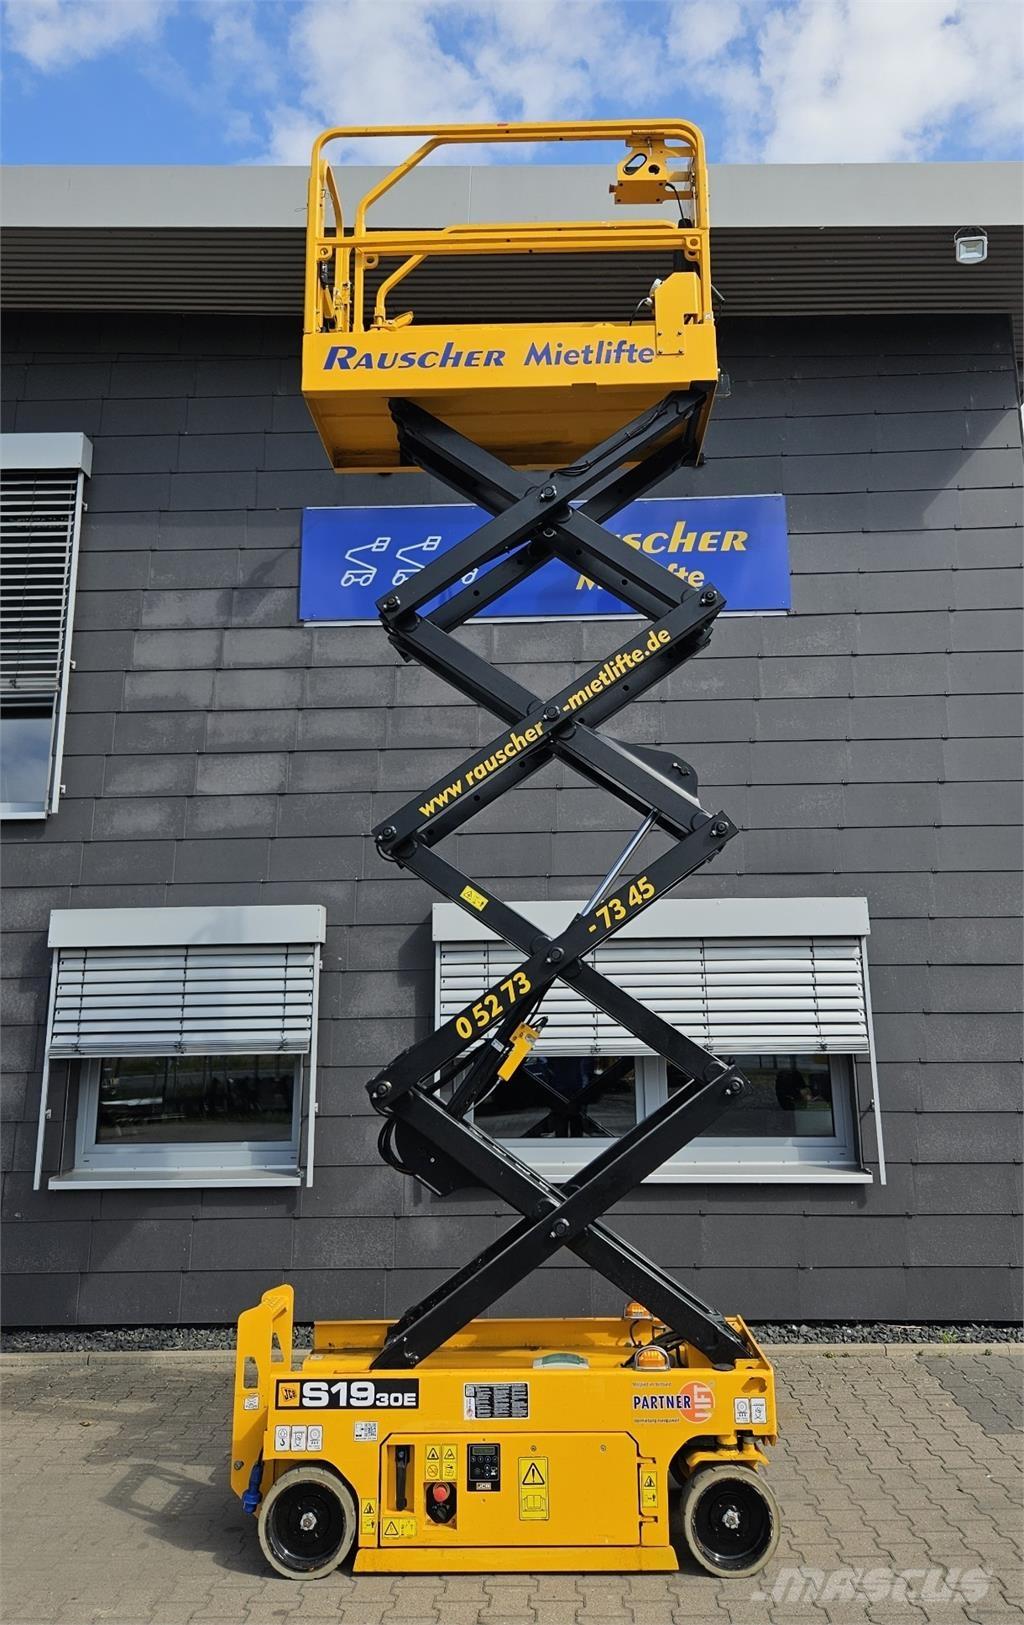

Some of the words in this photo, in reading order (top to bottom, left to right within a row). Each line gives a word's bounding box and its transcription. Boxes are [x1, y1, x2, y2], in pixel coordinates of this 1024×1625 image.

[523, 339, 655, 366] Mietlifte
[418, 779, 463, 817] www
[465, 721, 545, 787] rauscher
[455, 1016, 473, 1040] 0
[471, 993, 504, 1027] 52
[500, 971, 532, 1004] 73
[595, 898, 627, 929] 73
[628, 875, 656, 906] 45
[633, 1395, 691, 1409] PARTNER
